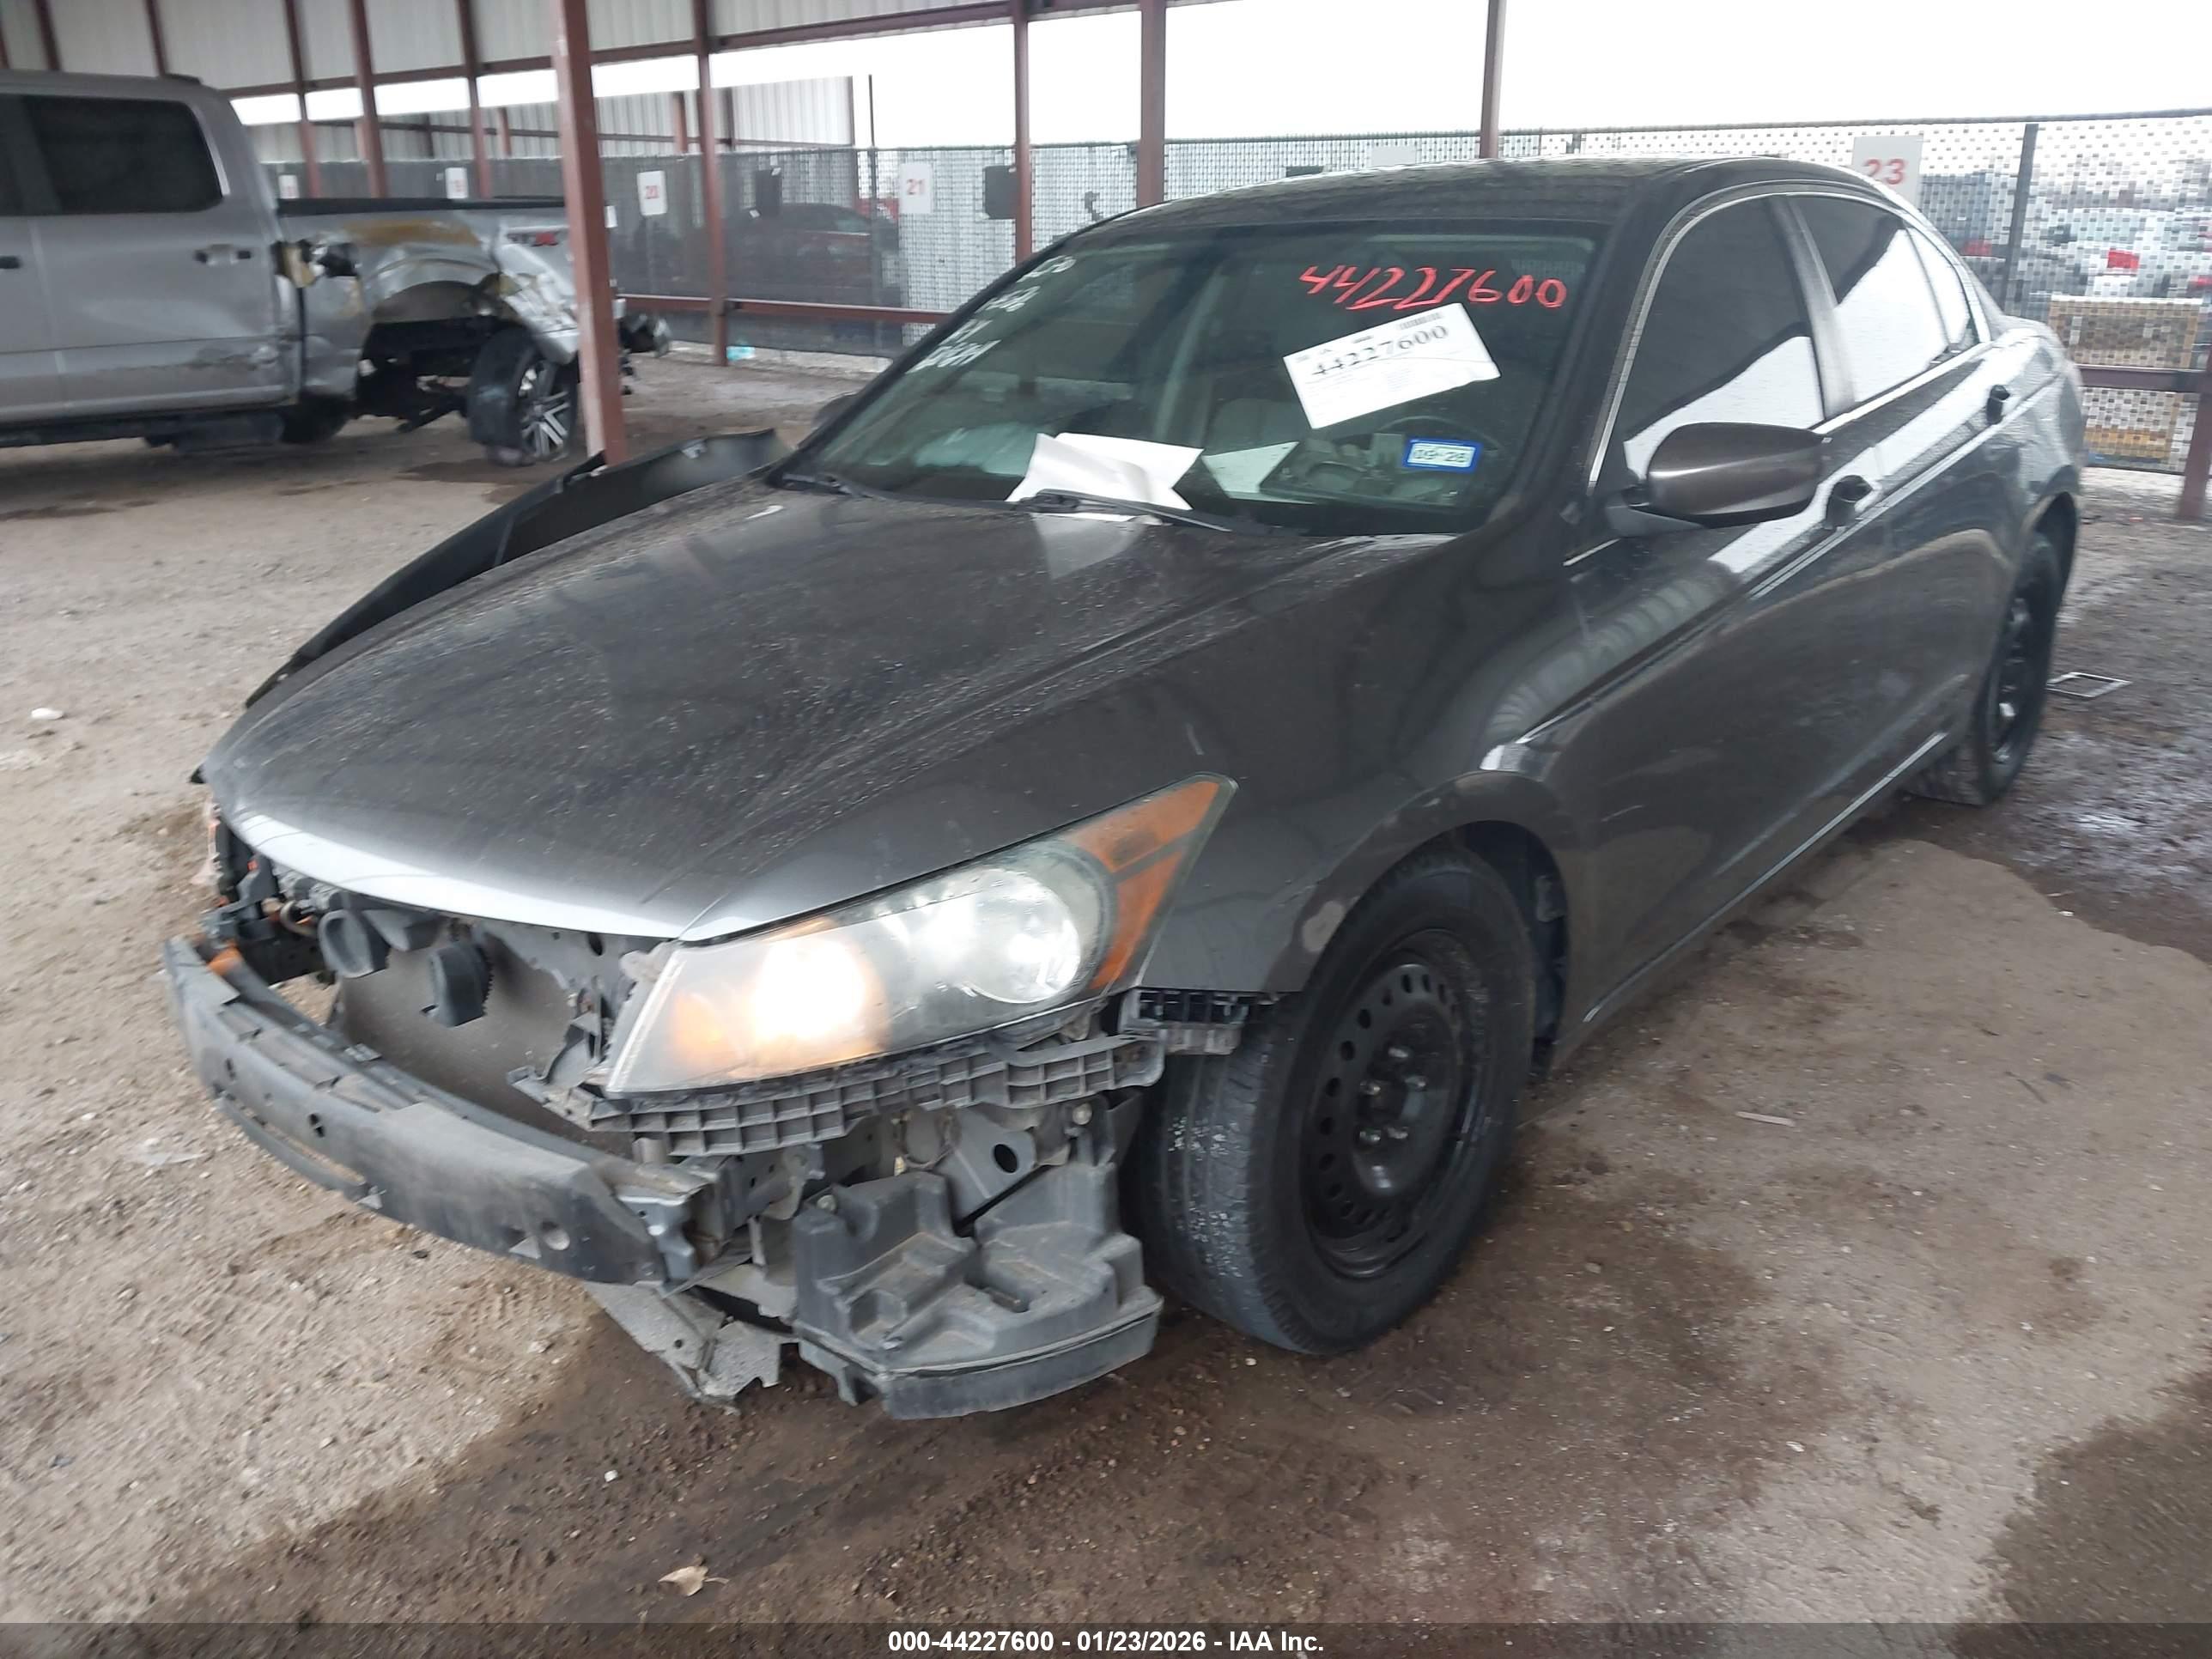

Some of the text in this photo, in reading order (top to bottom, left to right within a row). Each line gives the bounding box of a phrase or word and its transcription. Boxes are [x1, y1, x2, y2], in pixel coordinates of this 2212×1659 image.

[906, 179, 925, 196] 21
[1862, 159, 1905, 185] 23
[1299, 265, 1567, 308] 44227600
[1311, 325, 1449, 375] 44227600
